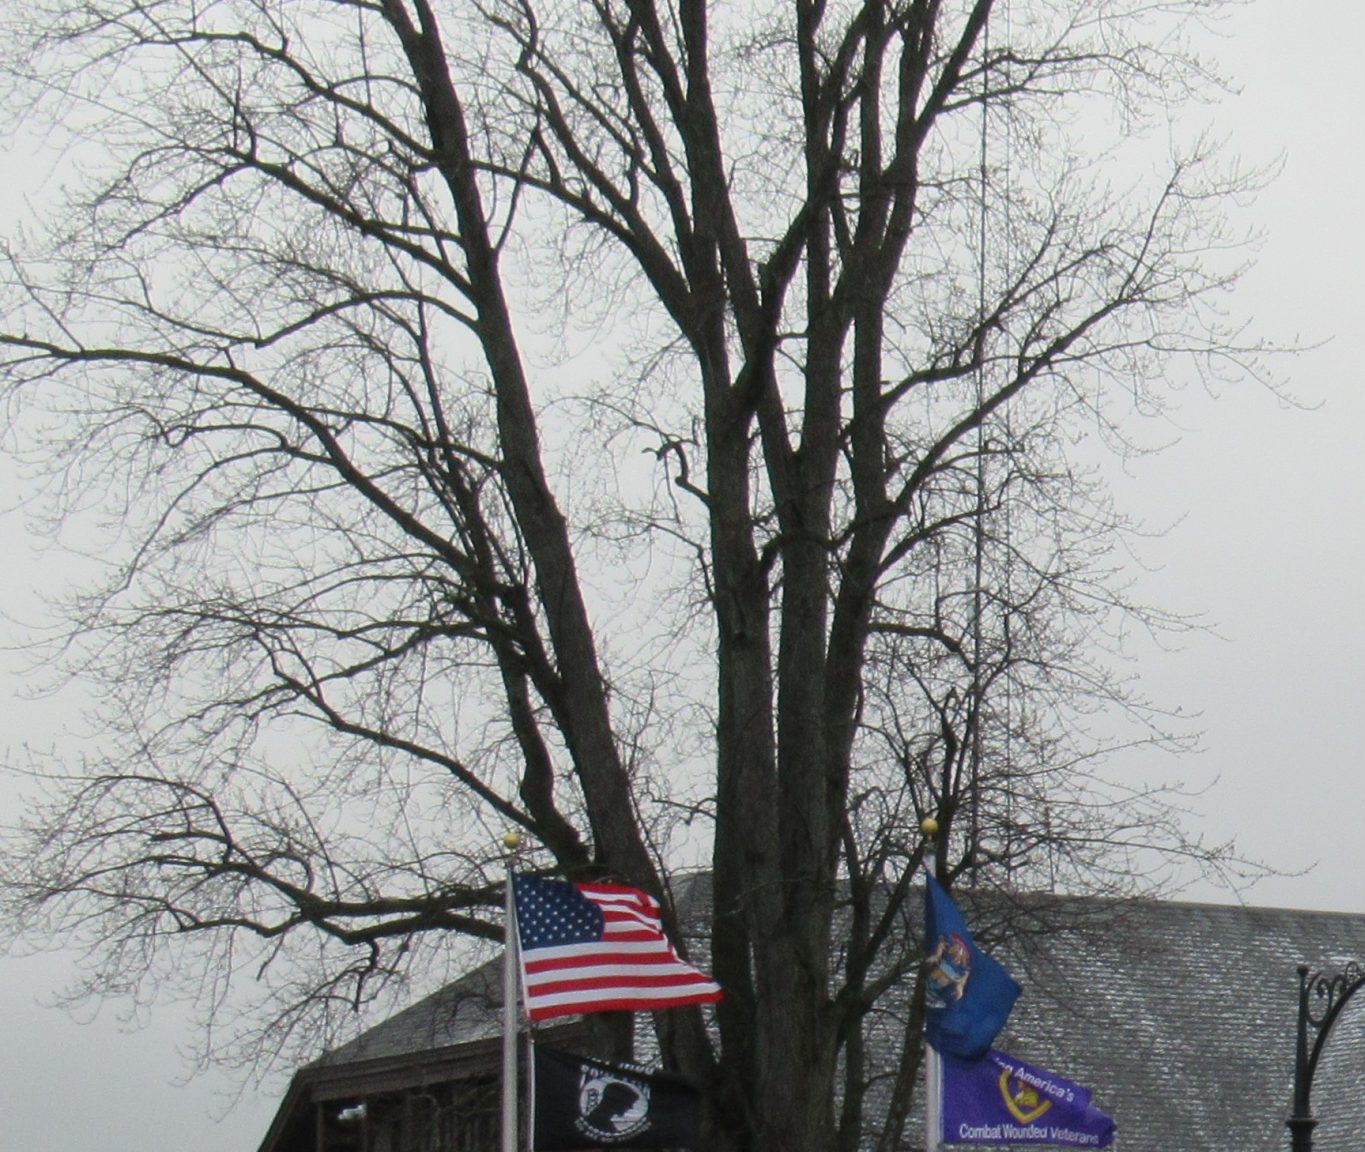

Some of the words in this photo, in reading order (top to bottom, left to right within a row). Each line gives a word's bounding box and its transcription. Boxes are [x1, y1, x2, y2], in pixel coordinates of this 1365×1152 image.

[1014, 1067, 1075, 1103] America's
[959, 1123, 1002, 1139] Combat
[1002, 1123, 1048, 1139] Wounded
[1050, 1126, 1099, 1145] Veterans
